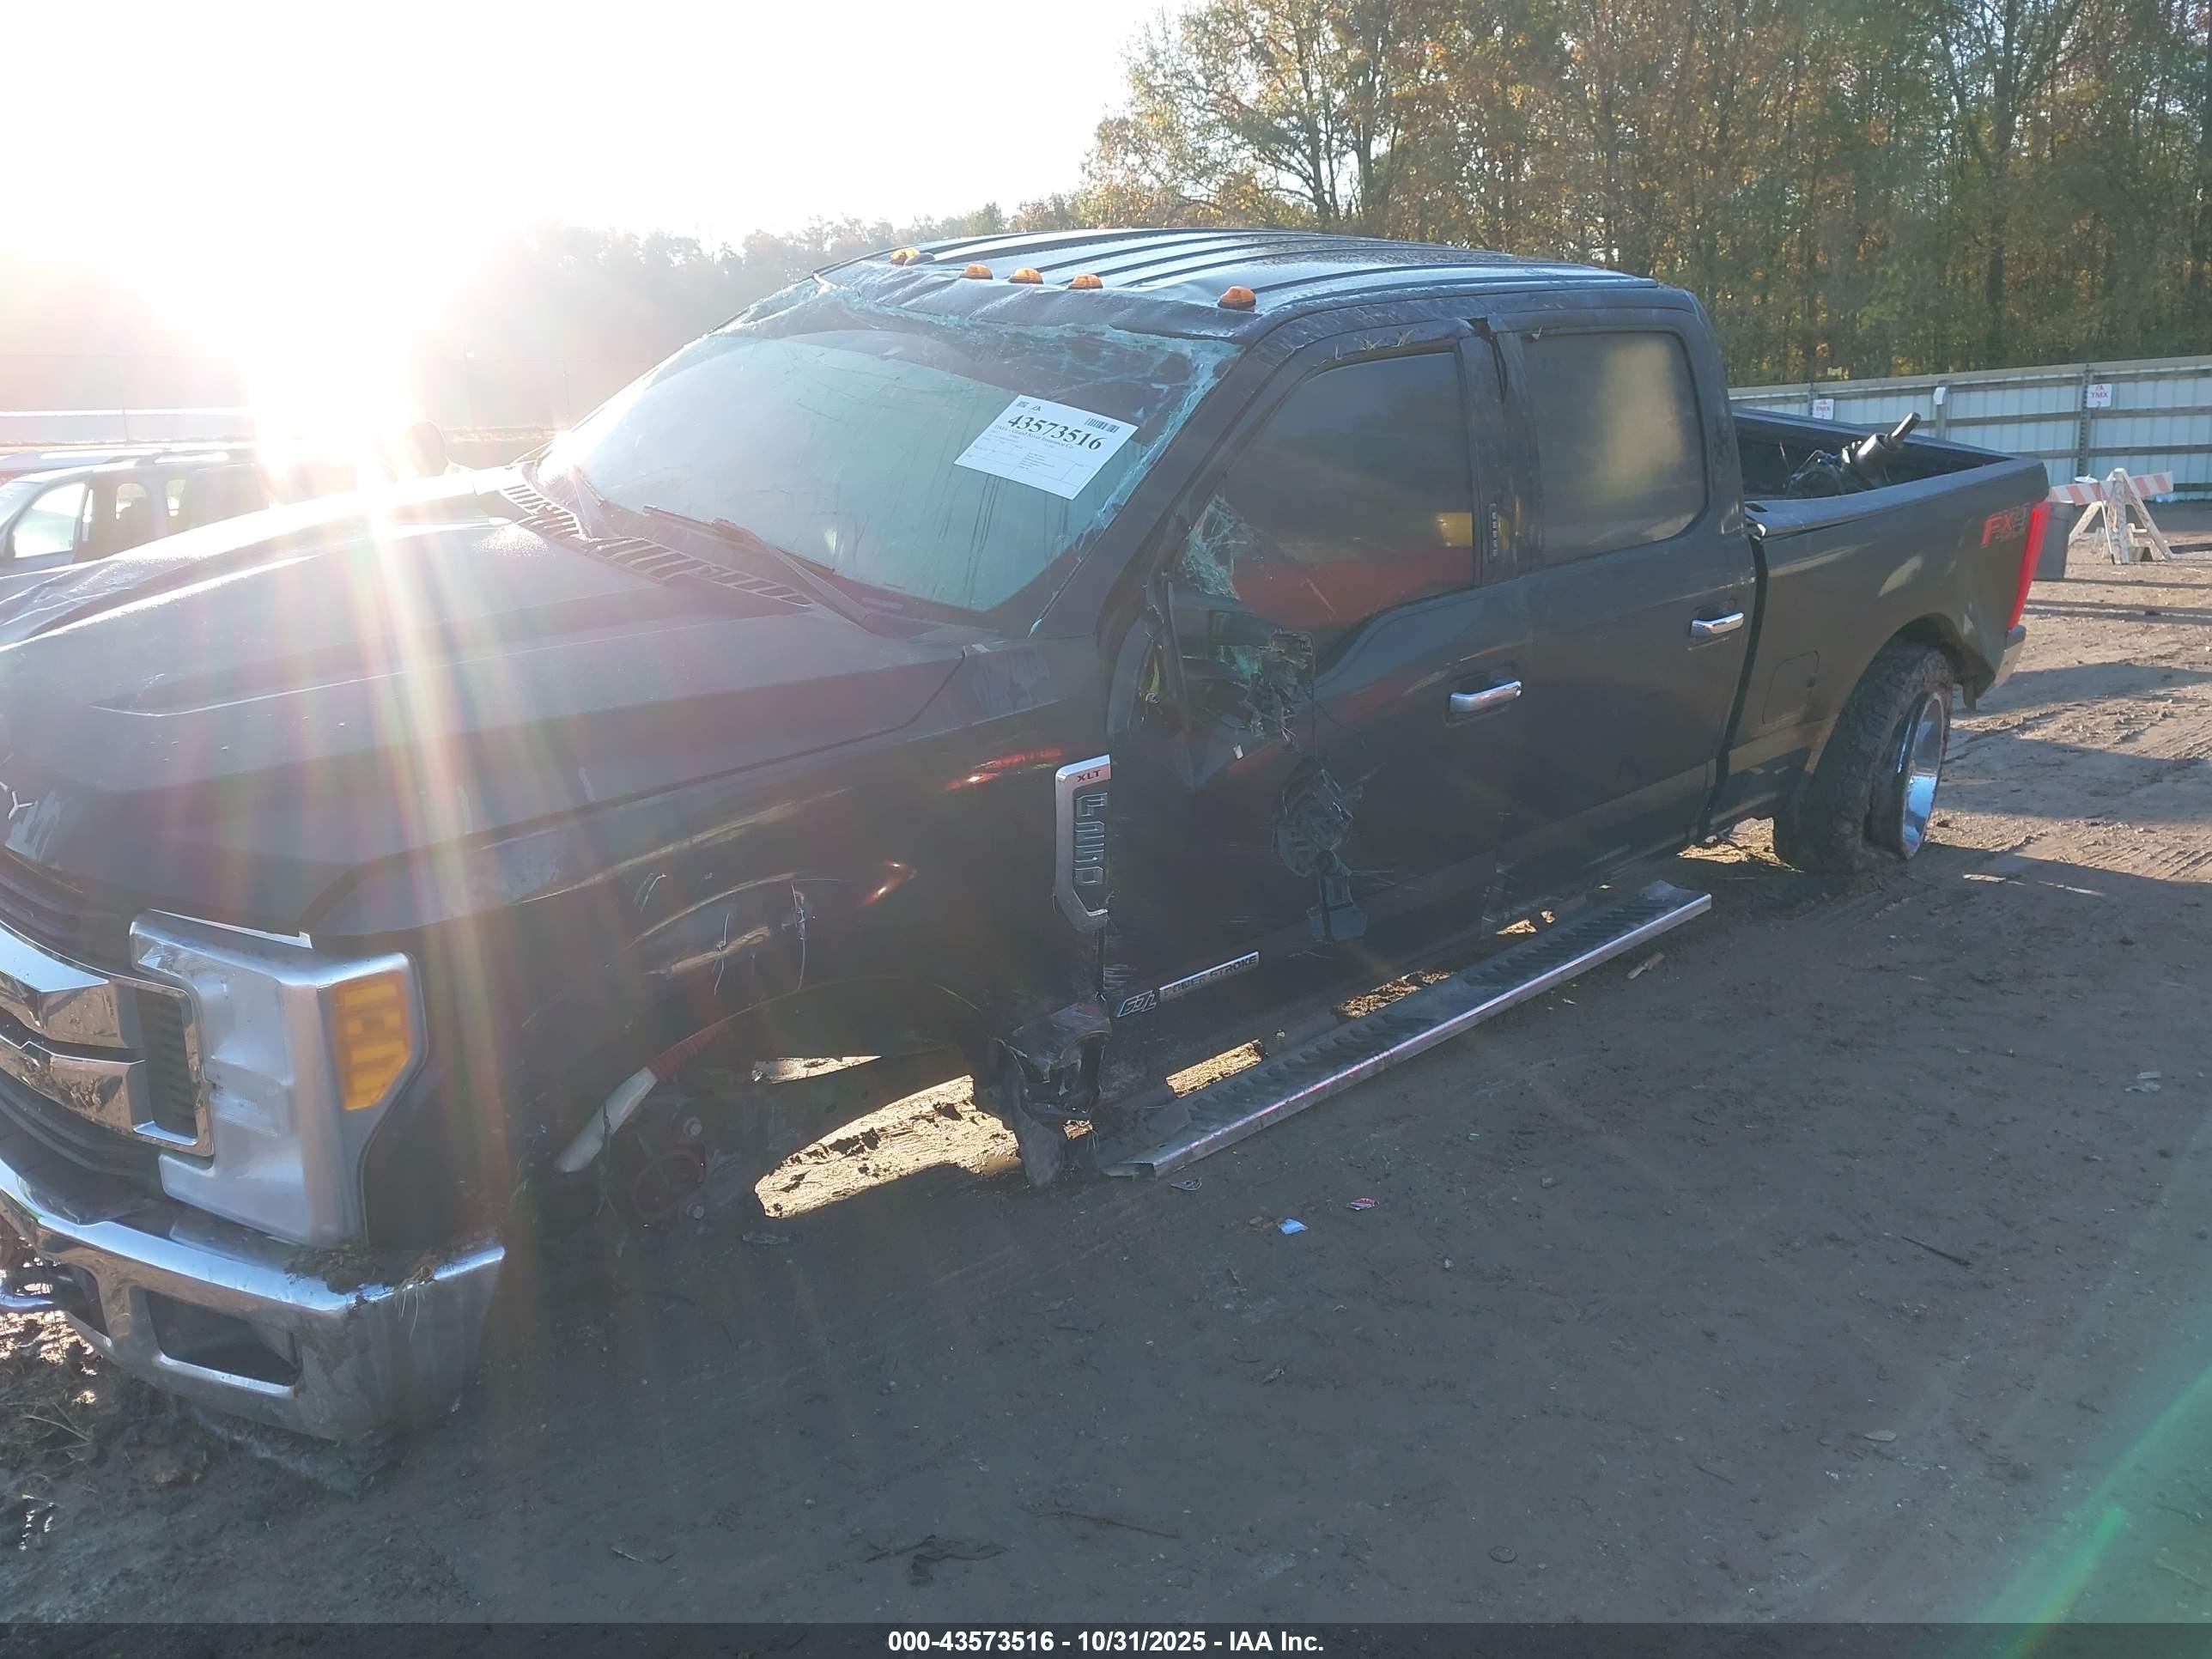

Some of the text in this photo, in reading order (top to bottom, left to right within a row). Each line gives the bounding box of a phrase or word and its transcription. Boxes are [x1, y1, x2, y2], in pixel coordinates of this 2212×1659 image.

[1007, 414, 1107, 450] 43573516
[1077, 769, 1101, 782] XLT
[1209, 955, 1258, 981] STROKE
